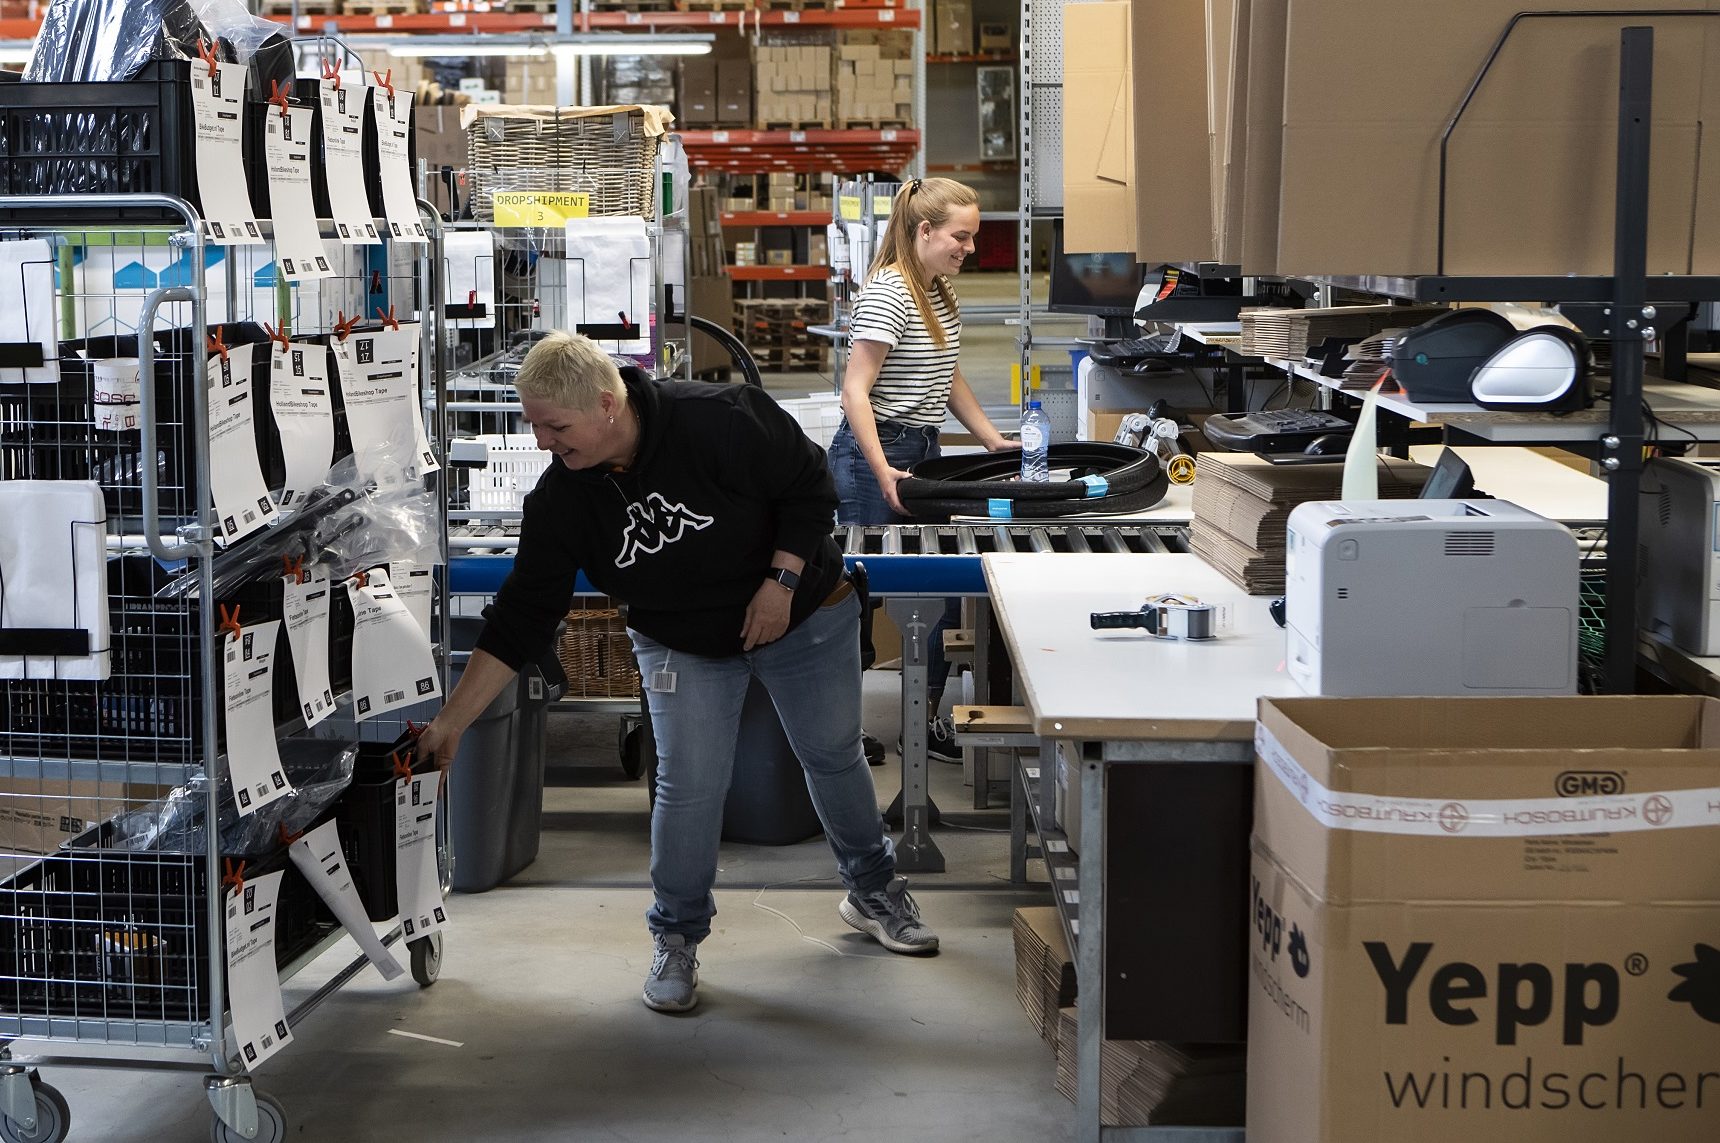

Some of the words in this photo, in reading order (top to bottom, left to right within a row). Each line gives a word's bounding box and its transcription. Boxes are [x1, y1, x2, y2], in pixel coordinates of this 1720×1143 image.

[497, 195, 585, 207] DROPSHIPMENT
[537, 211, 544, 221] 3
[420, 680, 431, 692] 86
[1504, 806, 1637, 825] KRUITBOSCH
